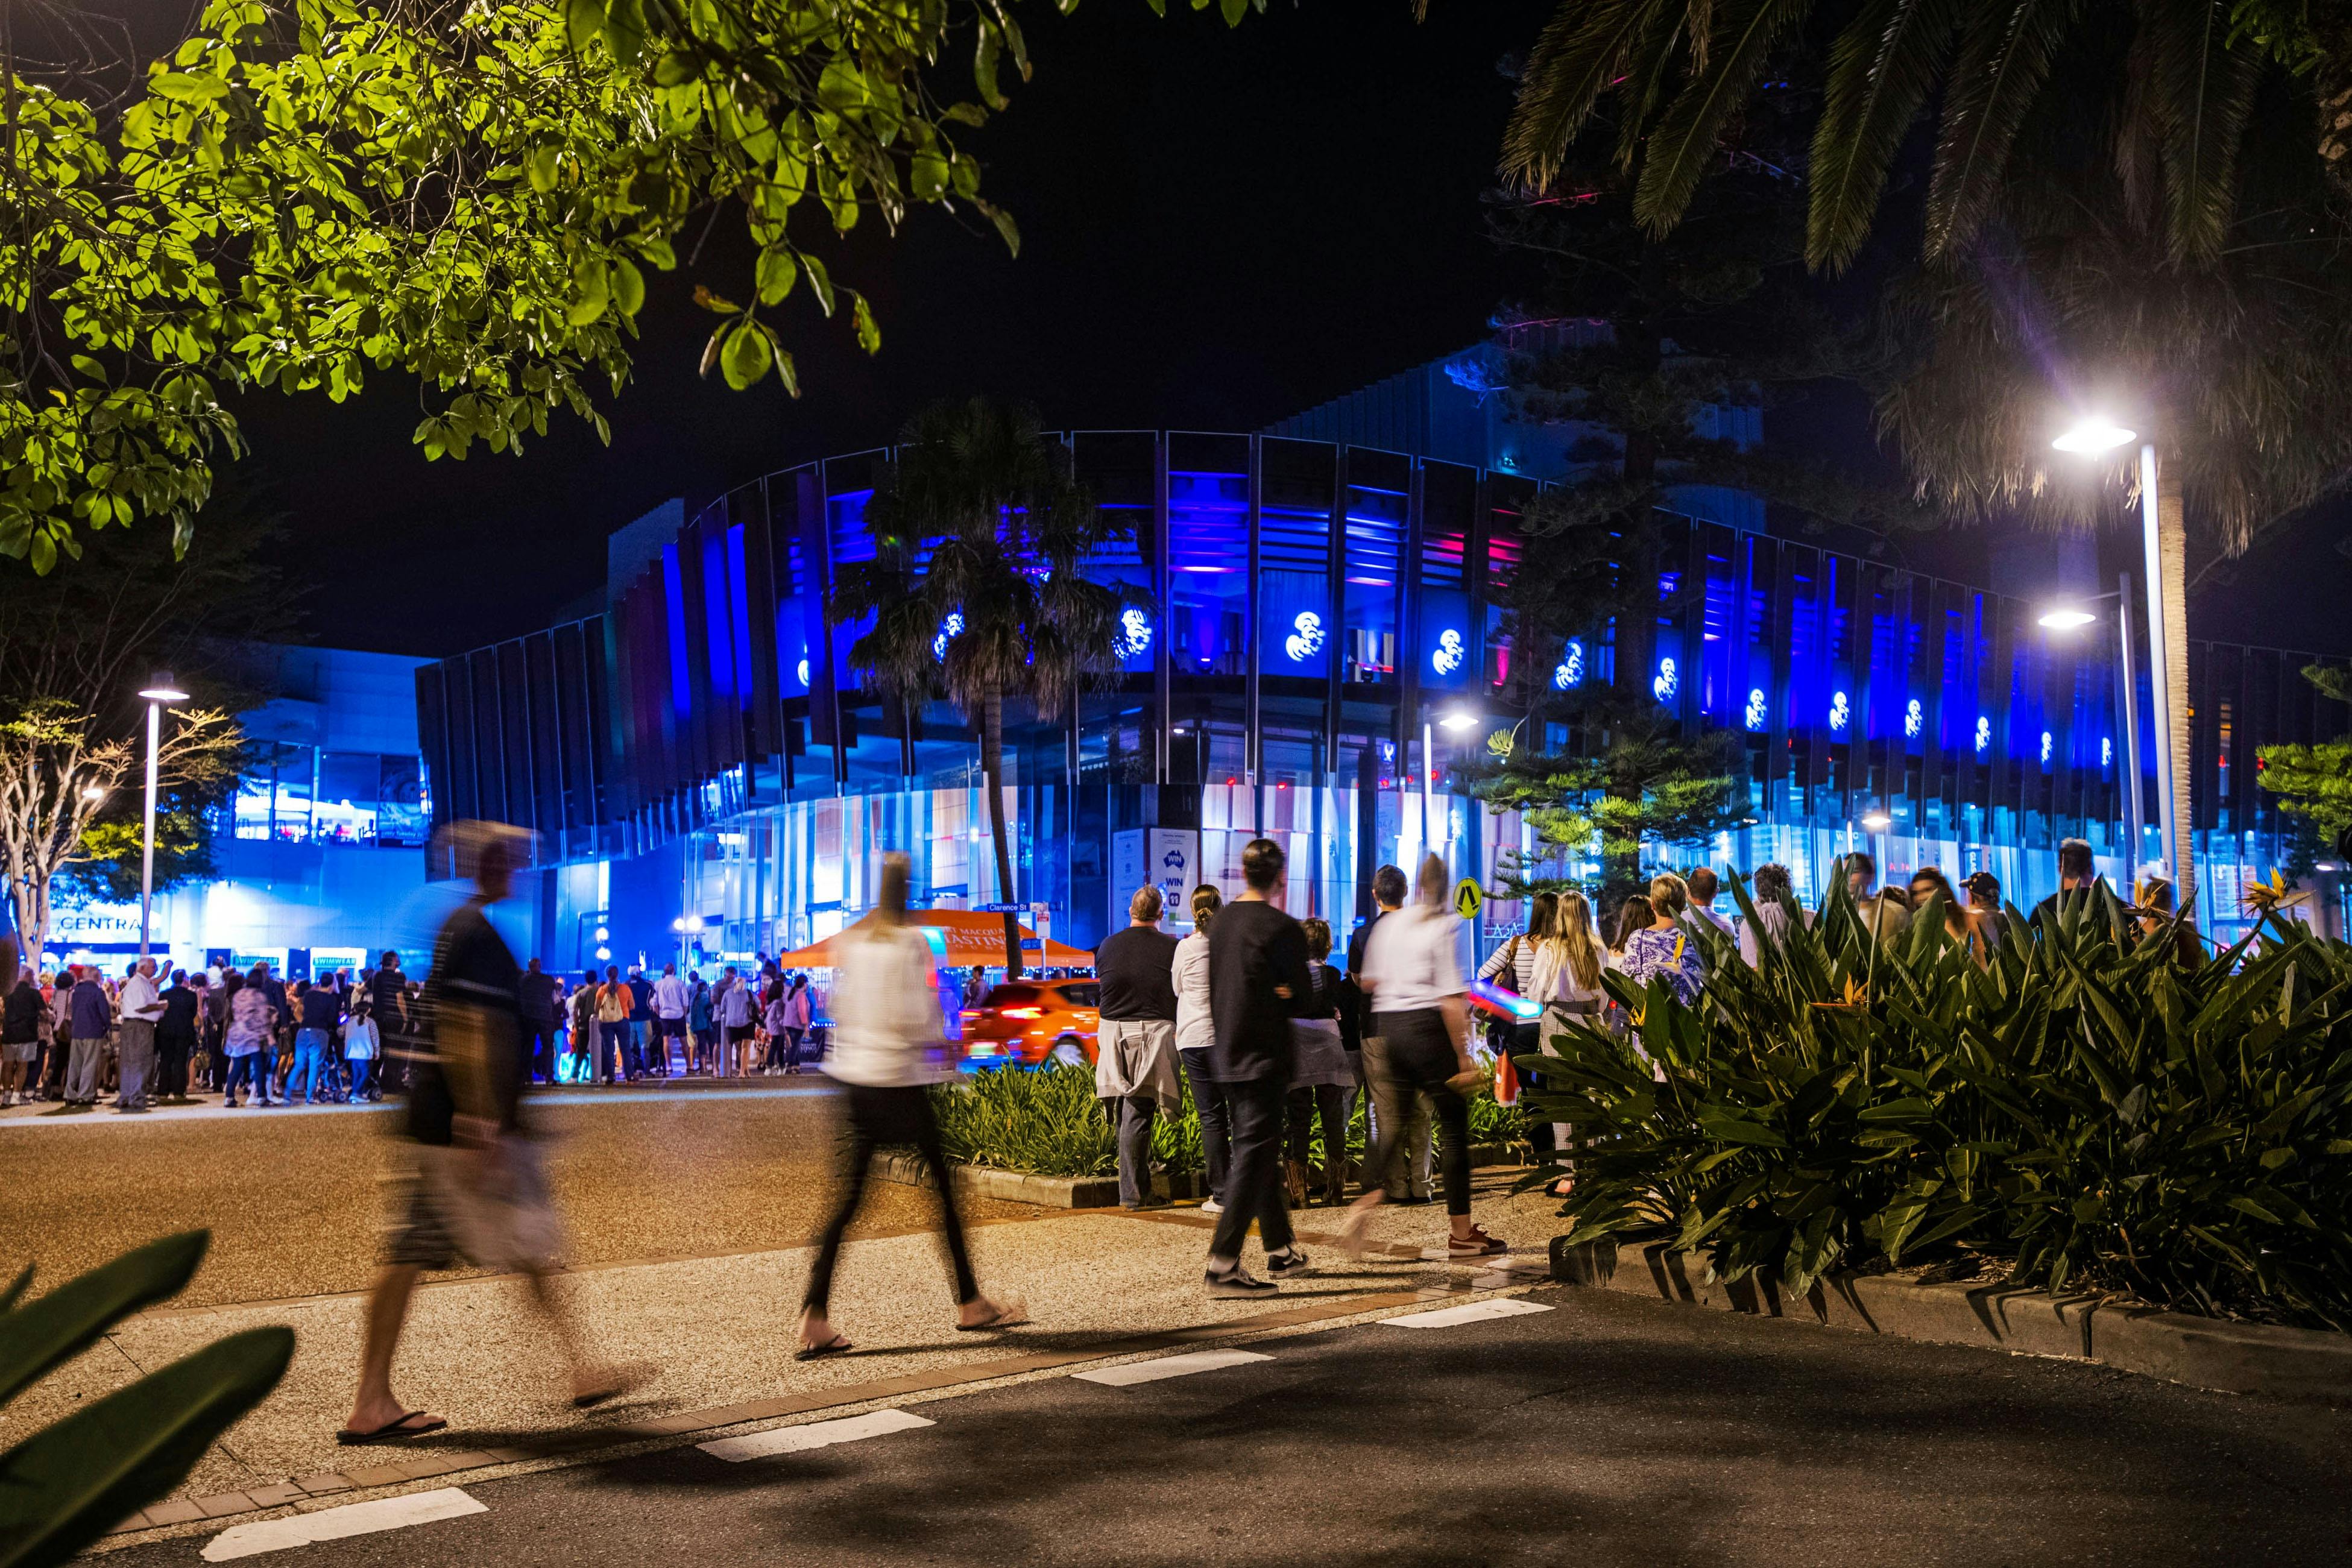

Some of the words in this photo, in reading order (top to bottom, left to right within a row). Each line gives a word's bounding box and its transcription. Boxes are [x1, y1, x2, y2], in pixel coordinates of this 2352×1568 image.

[1166, 878, 1183, 886] WIN
[60, 917, 142, 930] CENTRA
[959, 927, 1005, 936] MACQUA
[944, 934, 1006, 946] ASTIN
